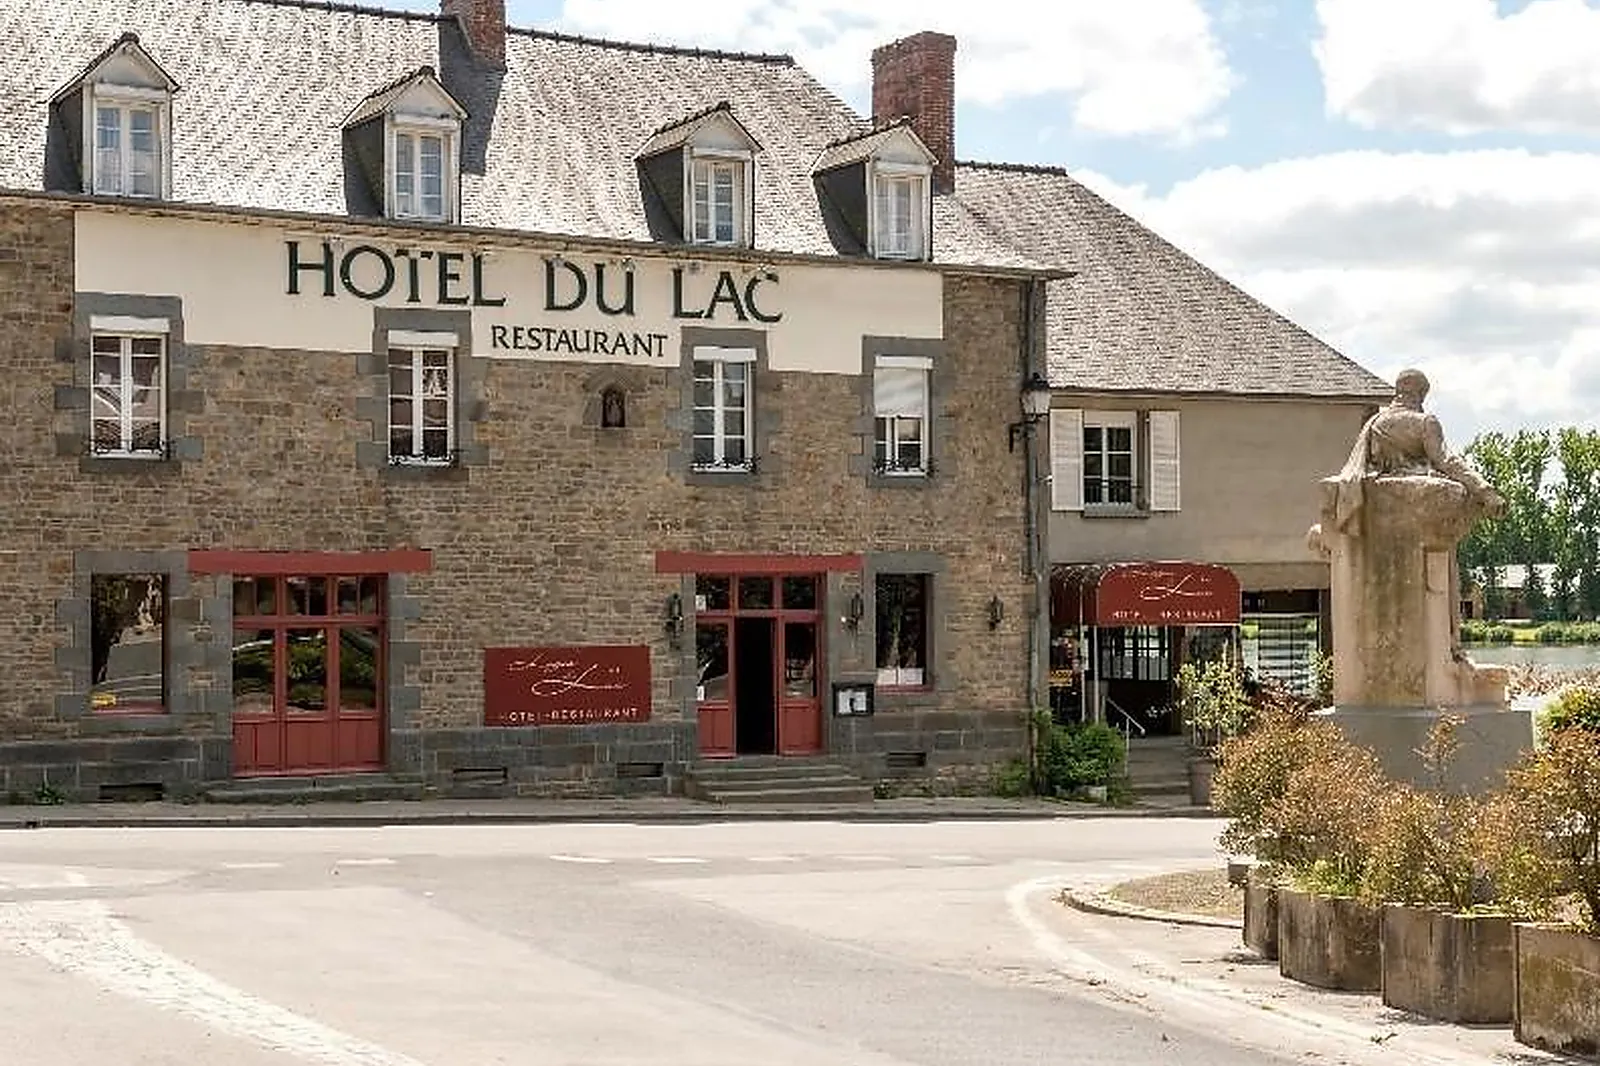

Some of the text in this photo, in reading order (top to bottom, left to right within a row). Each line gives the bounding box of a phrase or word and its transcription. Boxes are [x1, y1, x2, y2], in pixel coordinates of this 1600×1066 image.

[286, 241, 784, 323] HOTEL DU LAC
[492, 324, 668, 358] RESTAURANT
